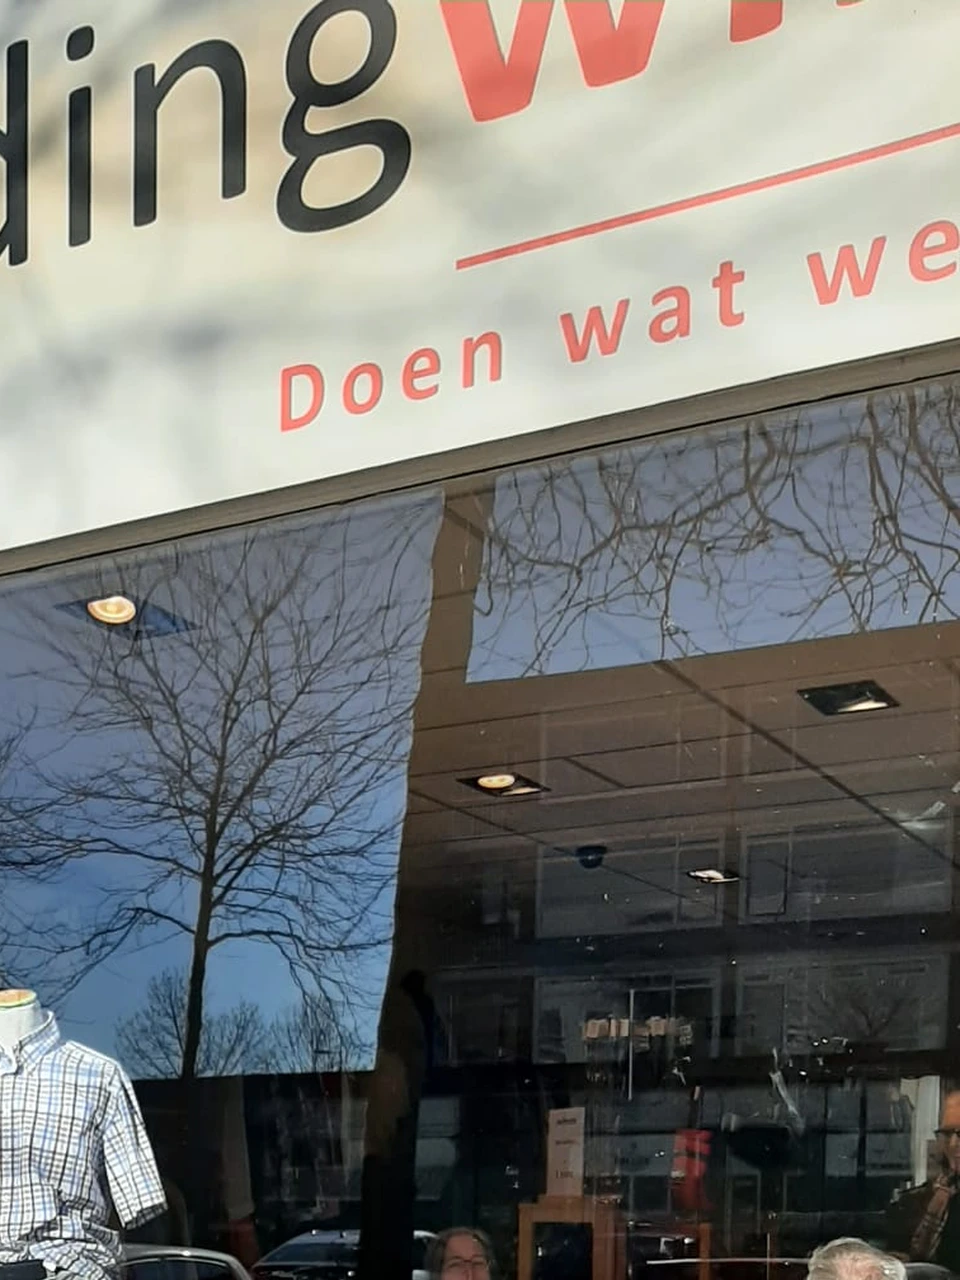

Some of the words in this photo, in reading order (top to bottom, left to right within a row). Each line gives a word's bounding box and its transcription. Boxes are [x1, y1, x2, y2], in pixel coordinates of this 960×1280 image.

[279, 328, 503, 433] Doen
[559, 260, 745, 363] wat
[807, 219, 960, 305] we
